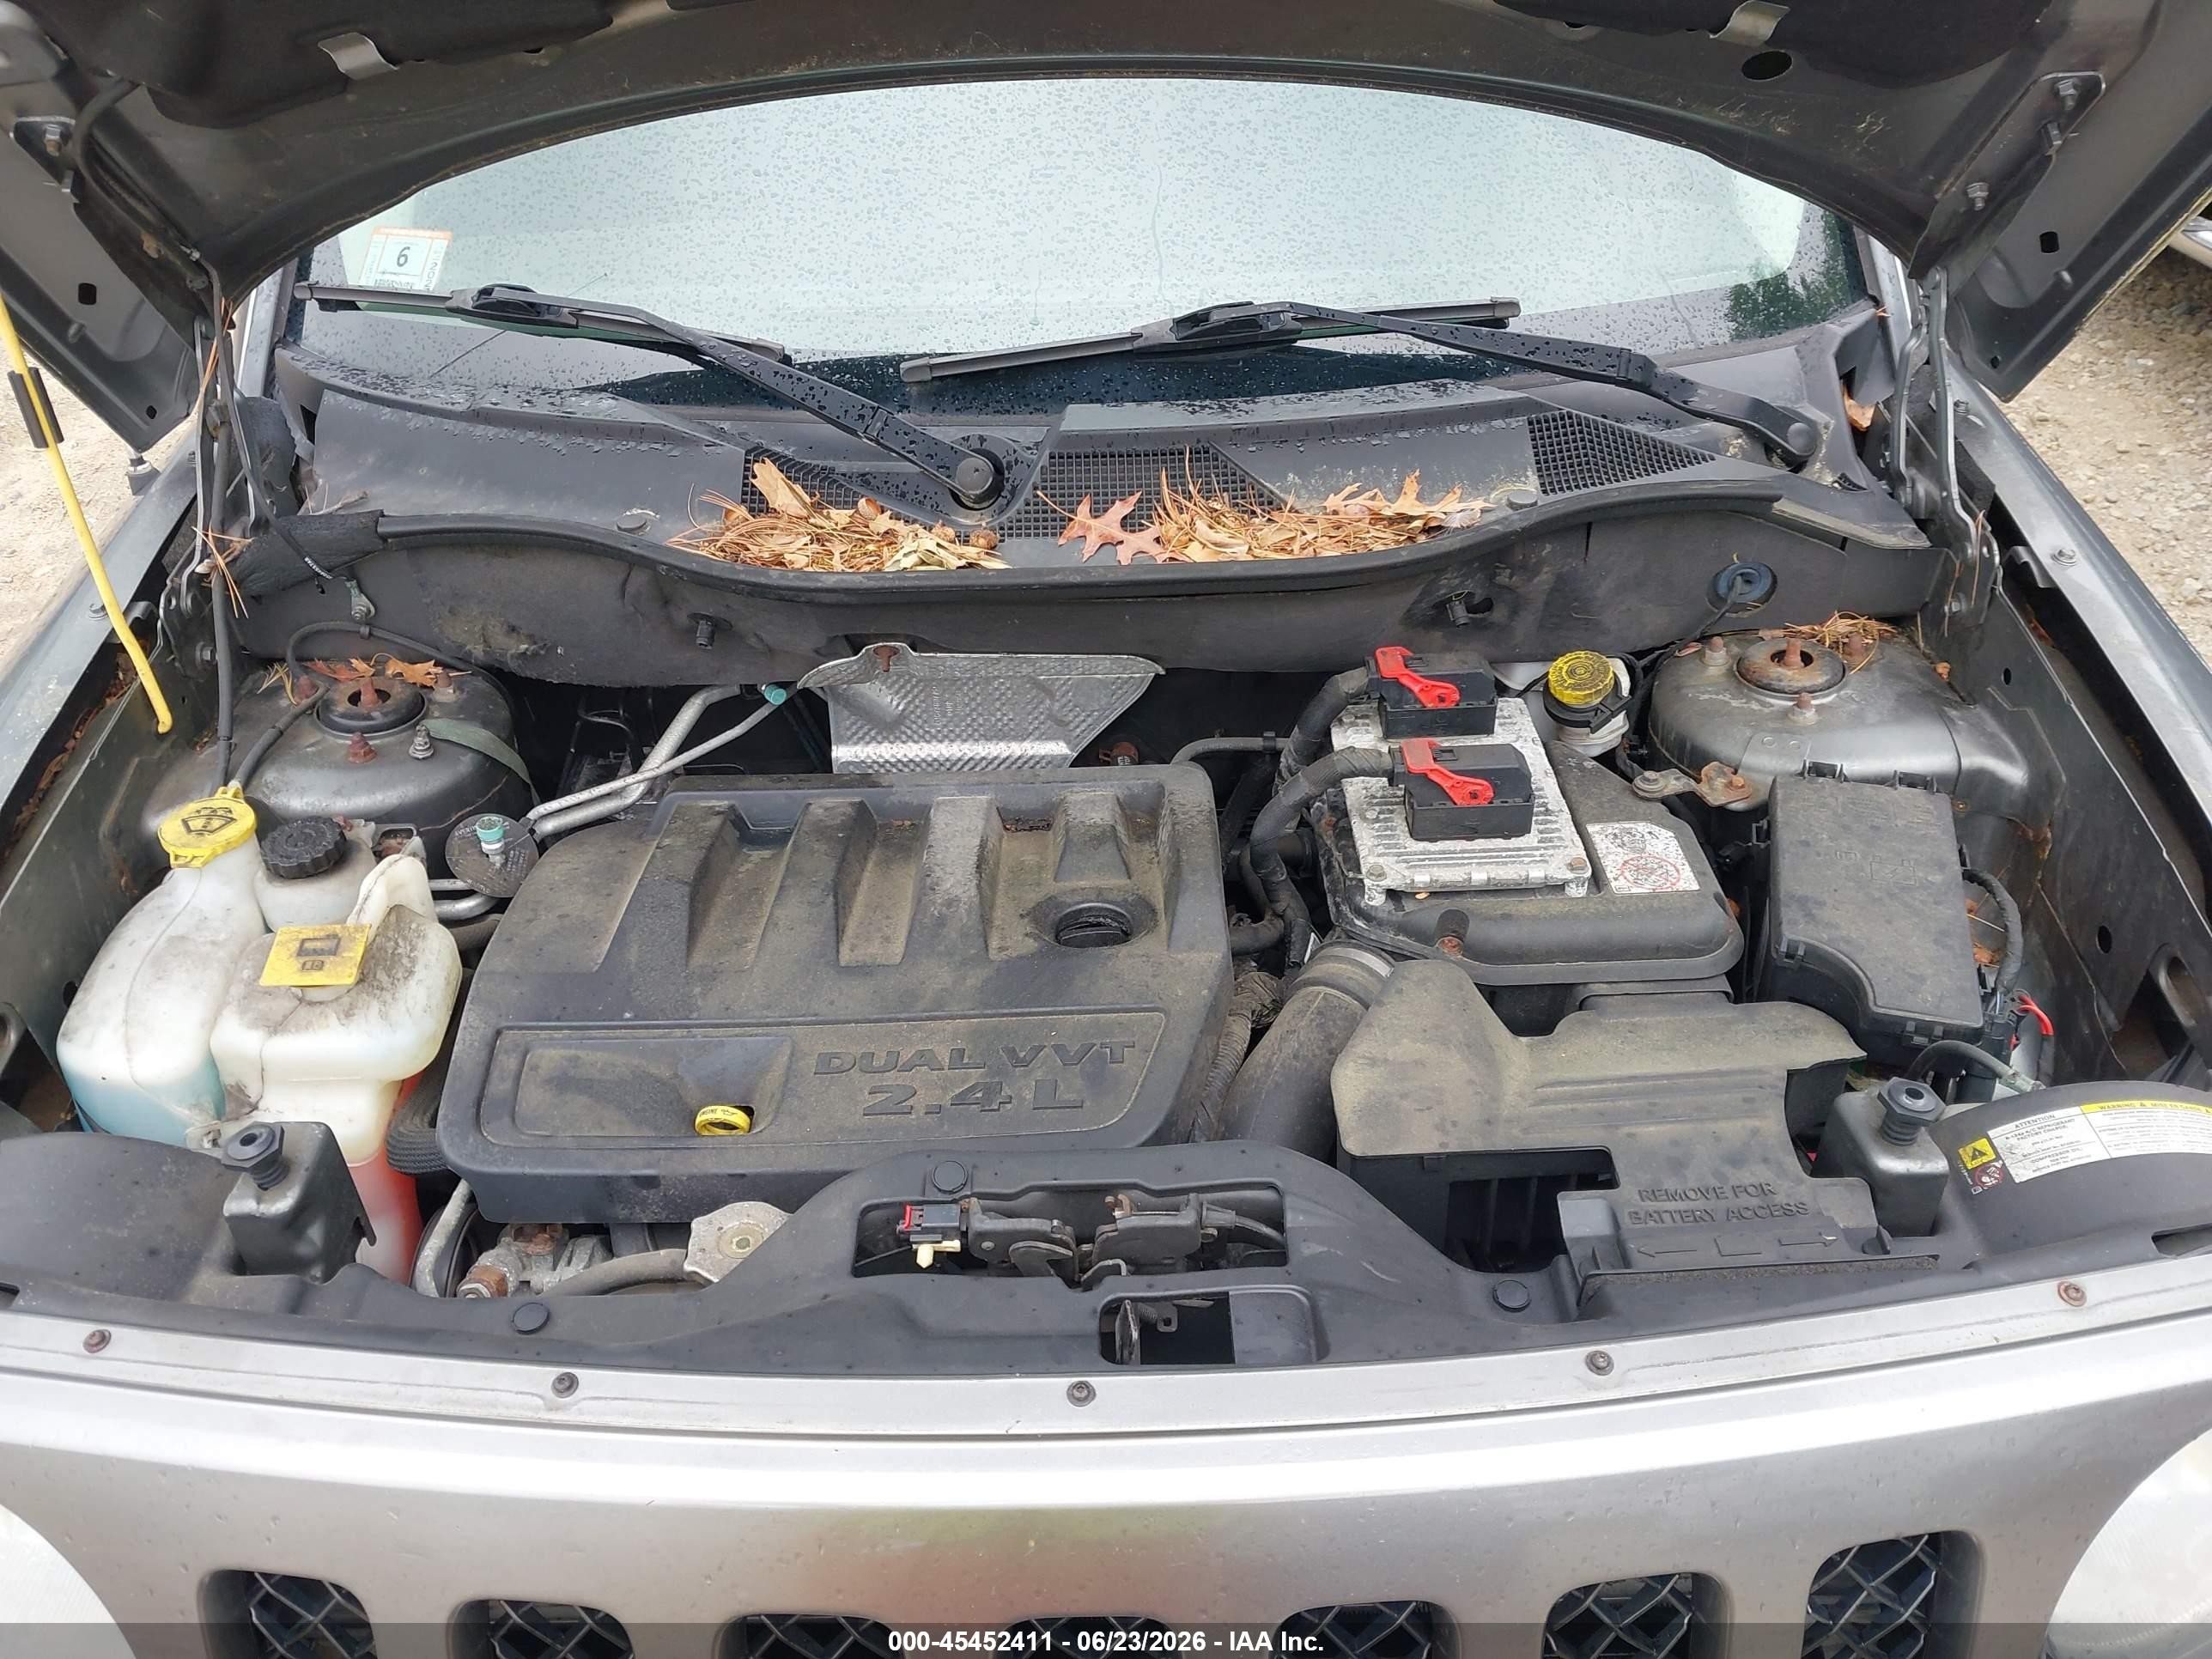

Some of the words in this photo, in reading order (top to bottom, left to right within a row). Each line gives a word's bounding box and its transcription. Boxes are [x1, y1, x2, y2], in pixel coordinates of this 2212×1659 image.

[396, 246, 411, 268] 6
[813, 1047, 987, 1076] DUAL
[1000, 1040, 1136, 1067] VVT
[2014, 1114, 2056, 1128] ATTENTION
[1638, 1185, 1729, 1202] REMOVE
[1731, 1182, 1778, 1198] FOR
[1628, 1207, 1717, 1225] BATTERY
[1726, 1202, 1810, 1222] ACCESS
